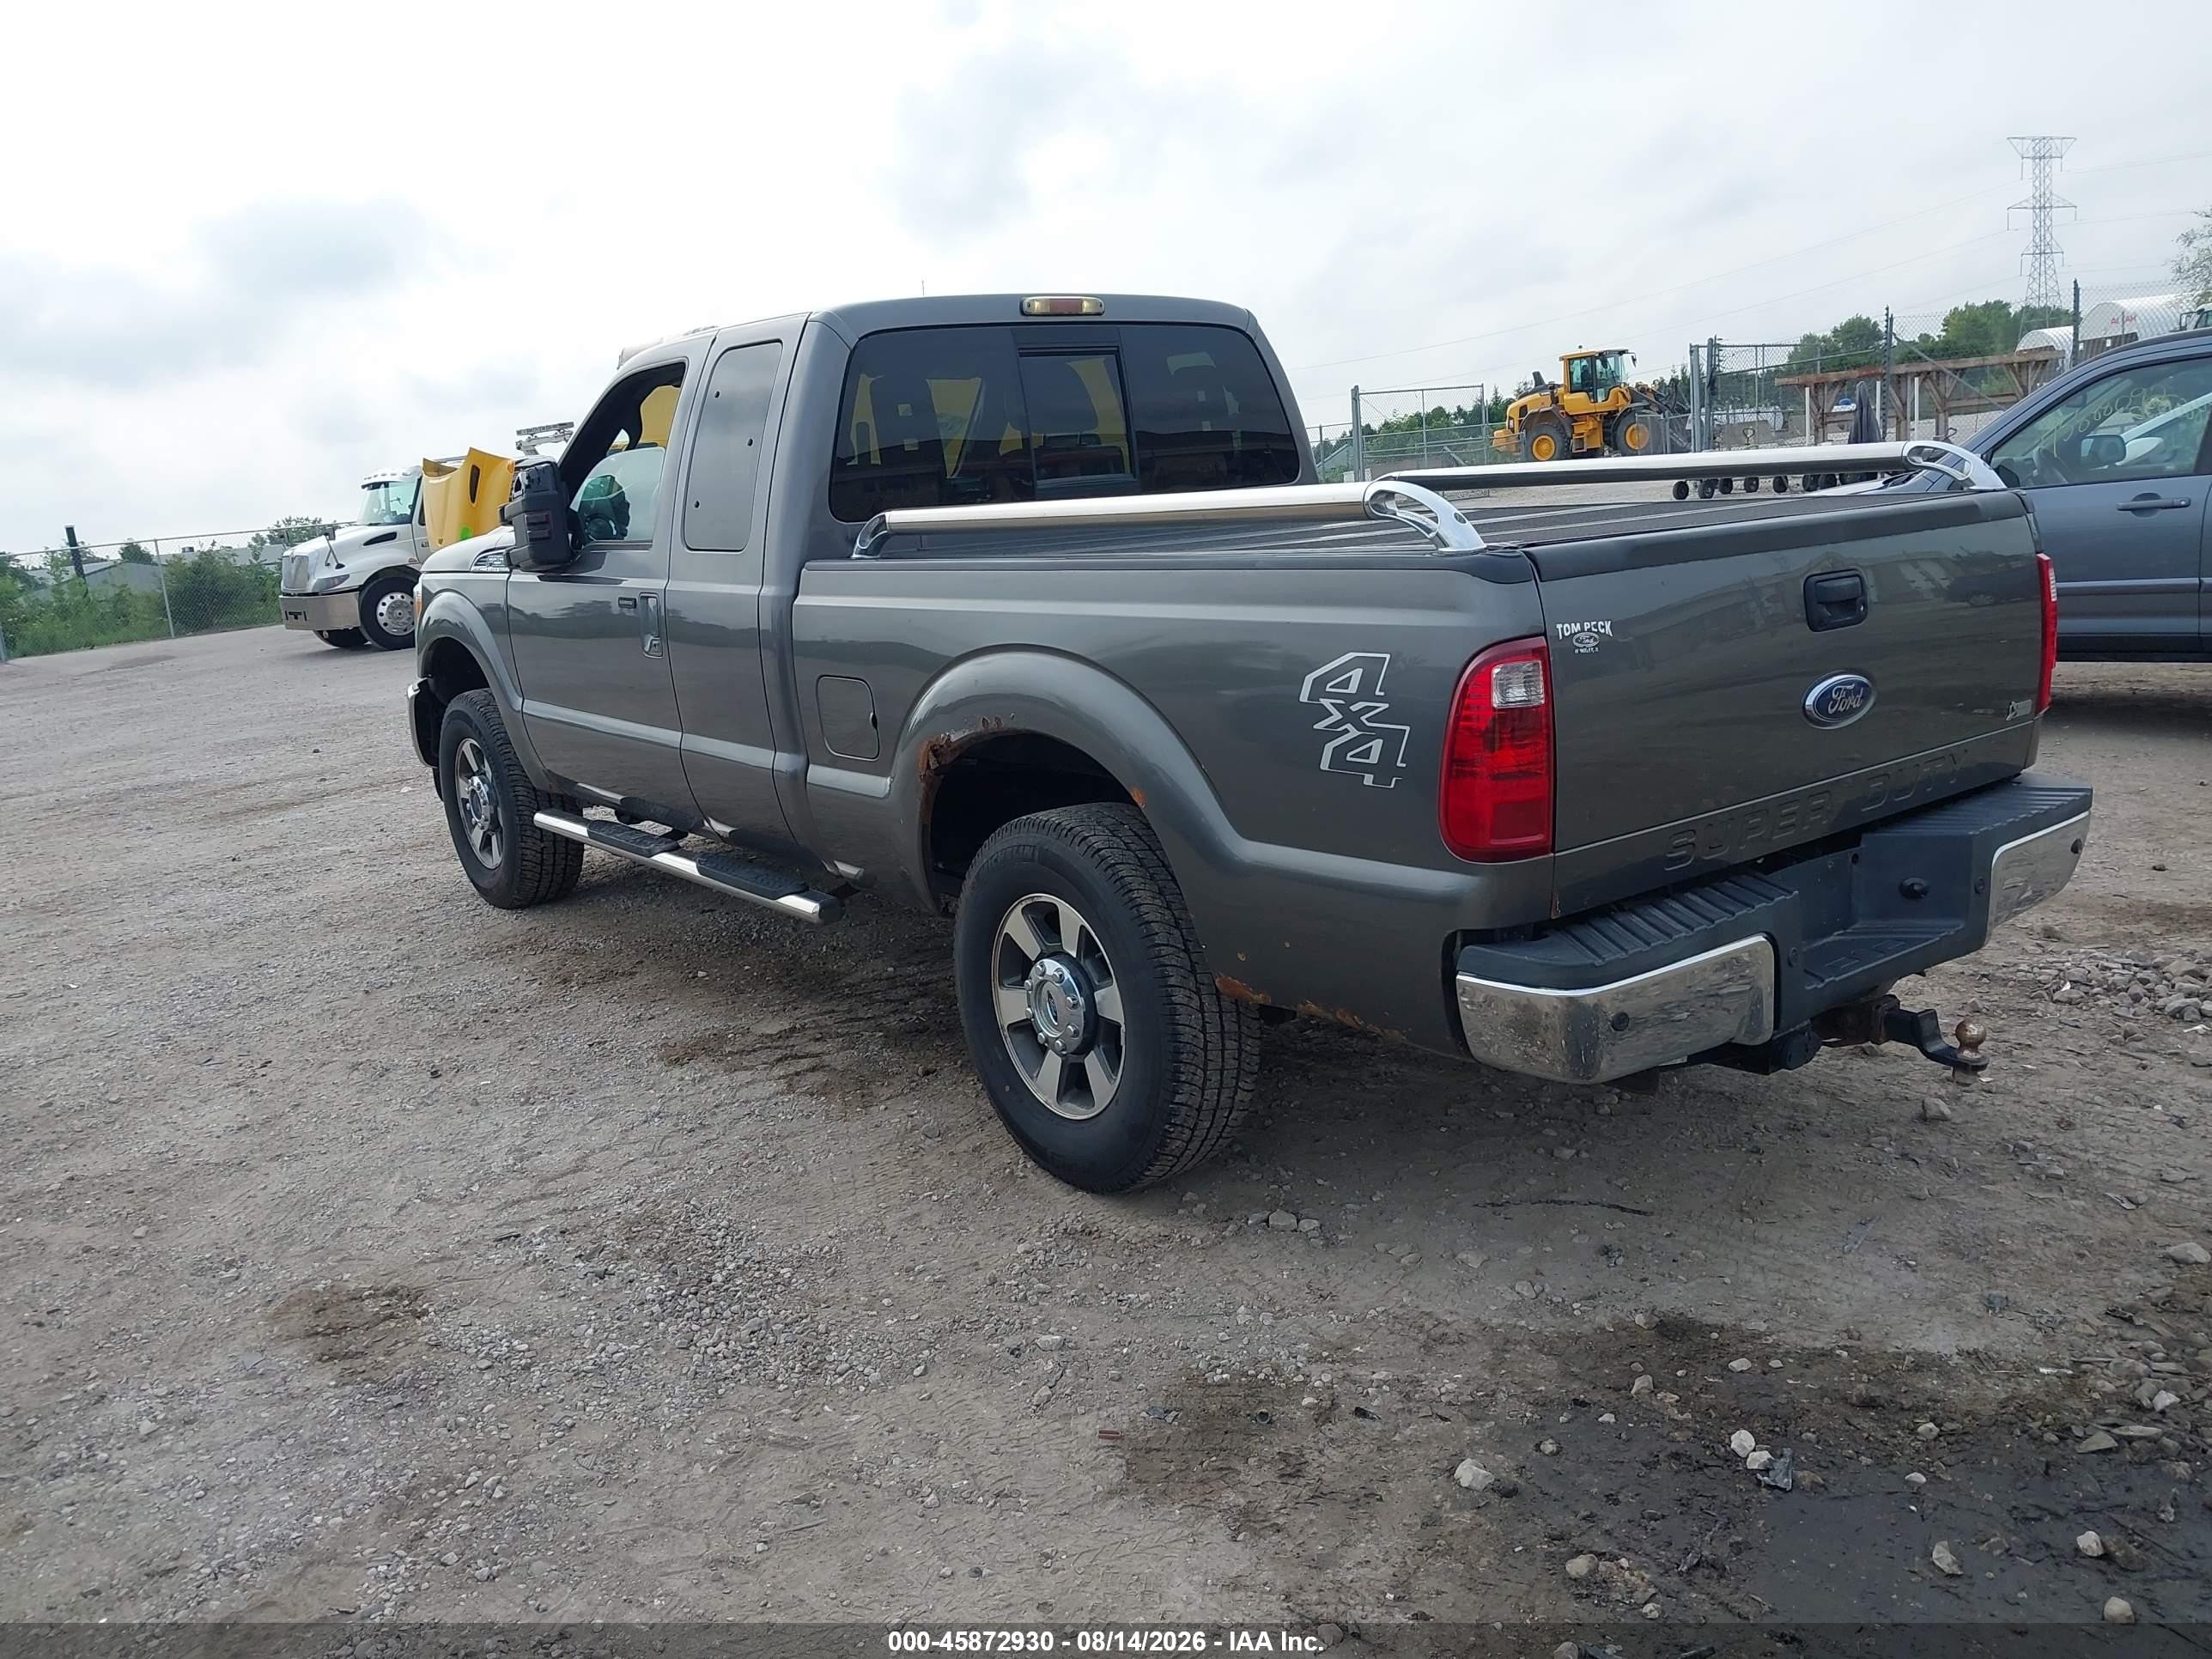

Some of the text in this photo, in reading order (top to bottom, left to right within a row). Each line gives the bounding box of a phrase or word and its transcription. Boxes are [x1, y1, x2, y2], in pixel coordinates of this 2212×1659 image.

[1556, 621, 1613, 640] TOM PECK
[1827, 684, 1863, 714] Ford
[1664, 749, 1968, 872] SUPER DUTY
